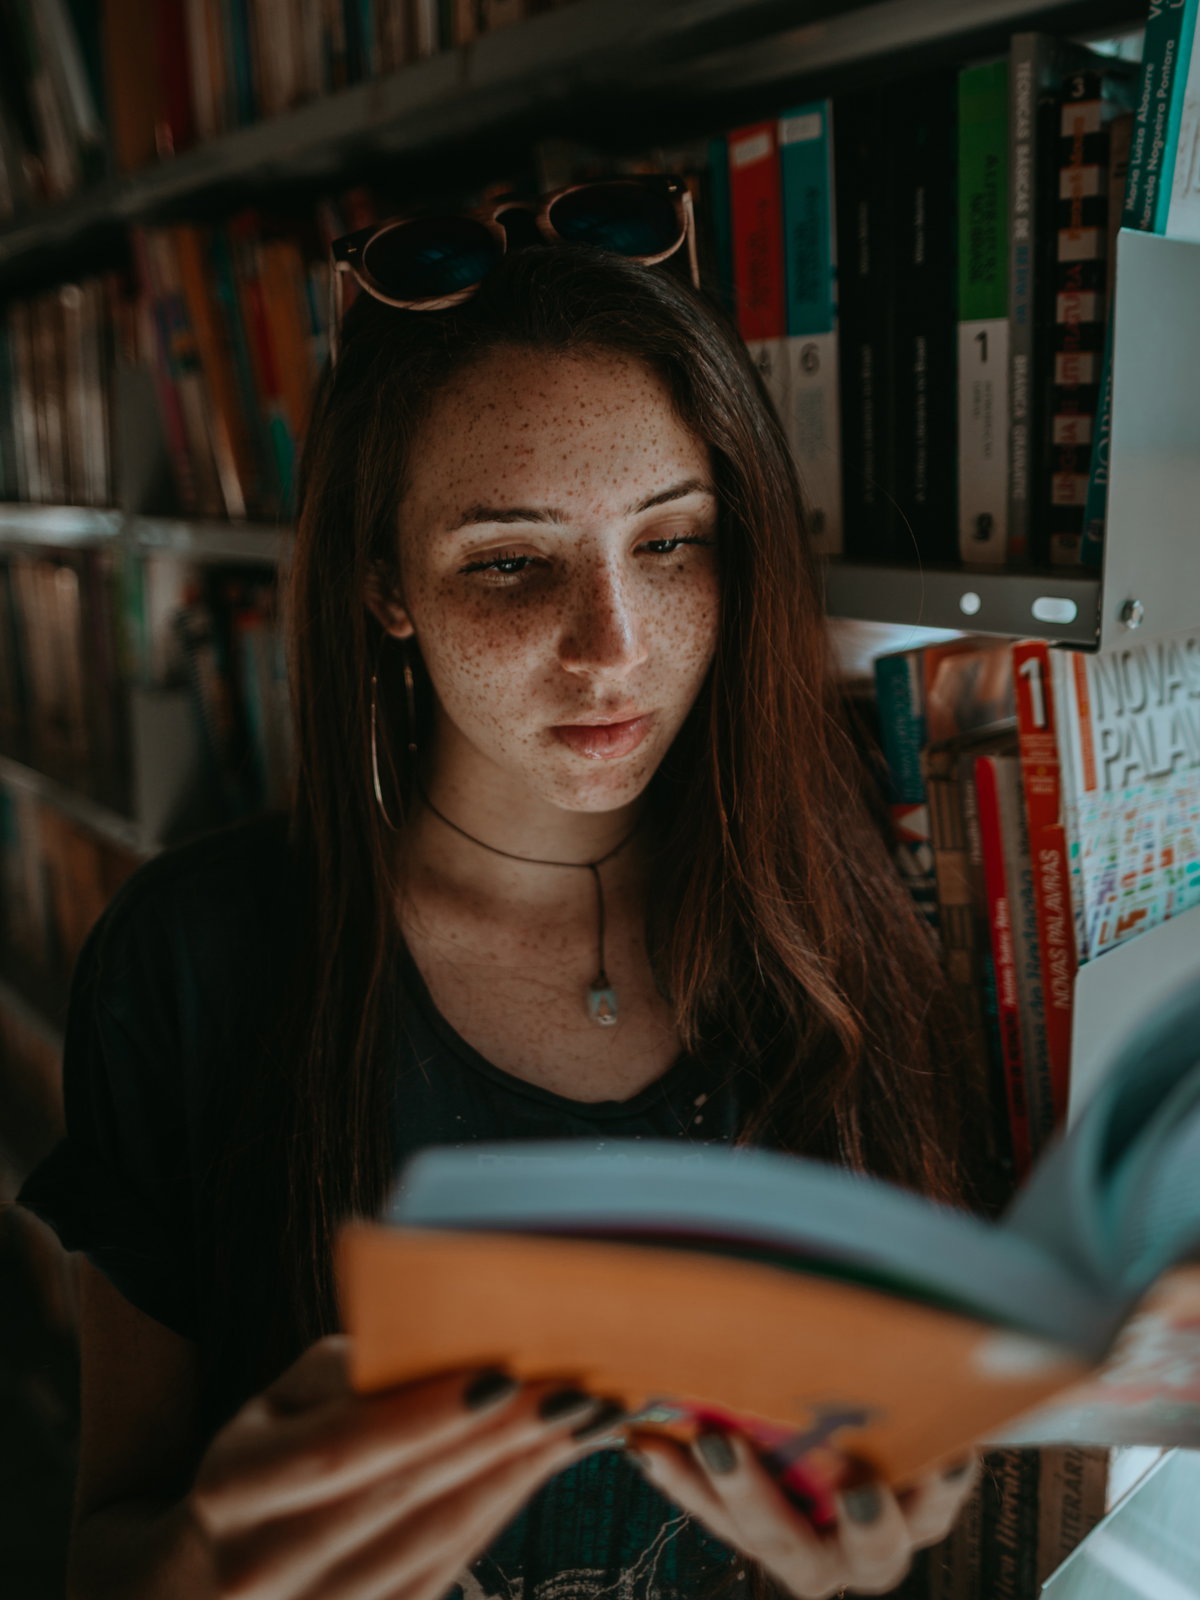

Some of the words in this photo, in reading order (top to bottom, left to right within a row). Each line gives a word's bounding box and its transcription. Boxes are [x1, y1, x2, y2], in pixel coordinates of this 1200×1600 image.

[1072, 77, 1085, 98] 3
[1136, 63, 1154, 122] Abaurre
[1156, 39, 1175, 98] Pontara
[1131, 127, 1145, 164] Luiza
[1147, 103, 1166, 170] Nogueira
[1125, 169, 1140, 210] Maria
[1140, 175, 1156, 230] Marcela
[973, 330, 989, 364] 1
[1019, 657, 1045, 728] 1
[1038, 848, 1066, 946] PALAVRAS
[1047, 947, 1072, 1010] NOVAS
